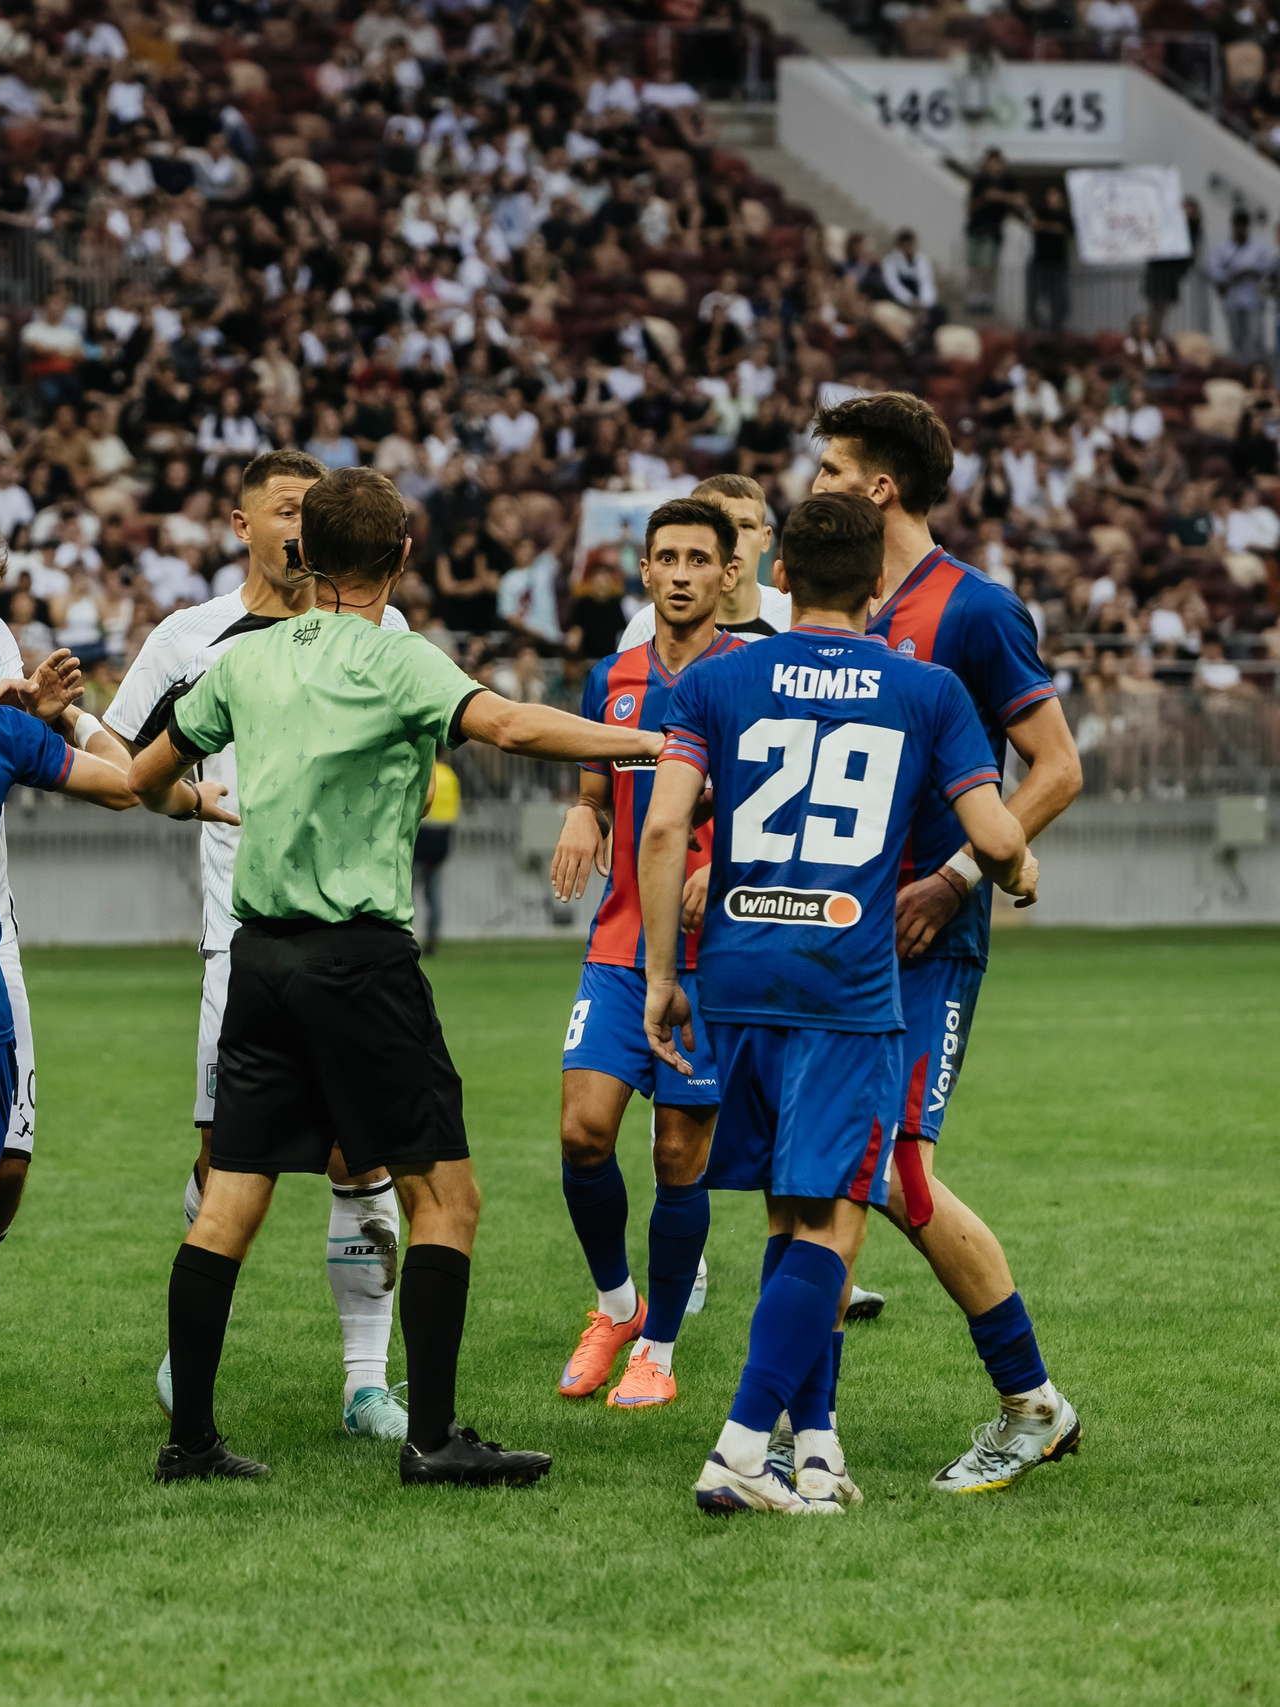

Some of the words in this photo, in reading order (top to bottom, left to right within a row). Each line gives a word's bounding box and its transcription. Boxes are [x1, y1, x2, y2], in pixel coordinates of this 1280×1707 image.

[874, 90, 954, 131] 146
[1027, 91, 1105, 132] 145
[772, 663, 882, 699] KOMIS
[730, 718, 906, 868] 29
[739, 894, 820, 917] Winline
[564, 1000, 592, 1052] 8
[928, 1000, 961, 1112] Vorgol
